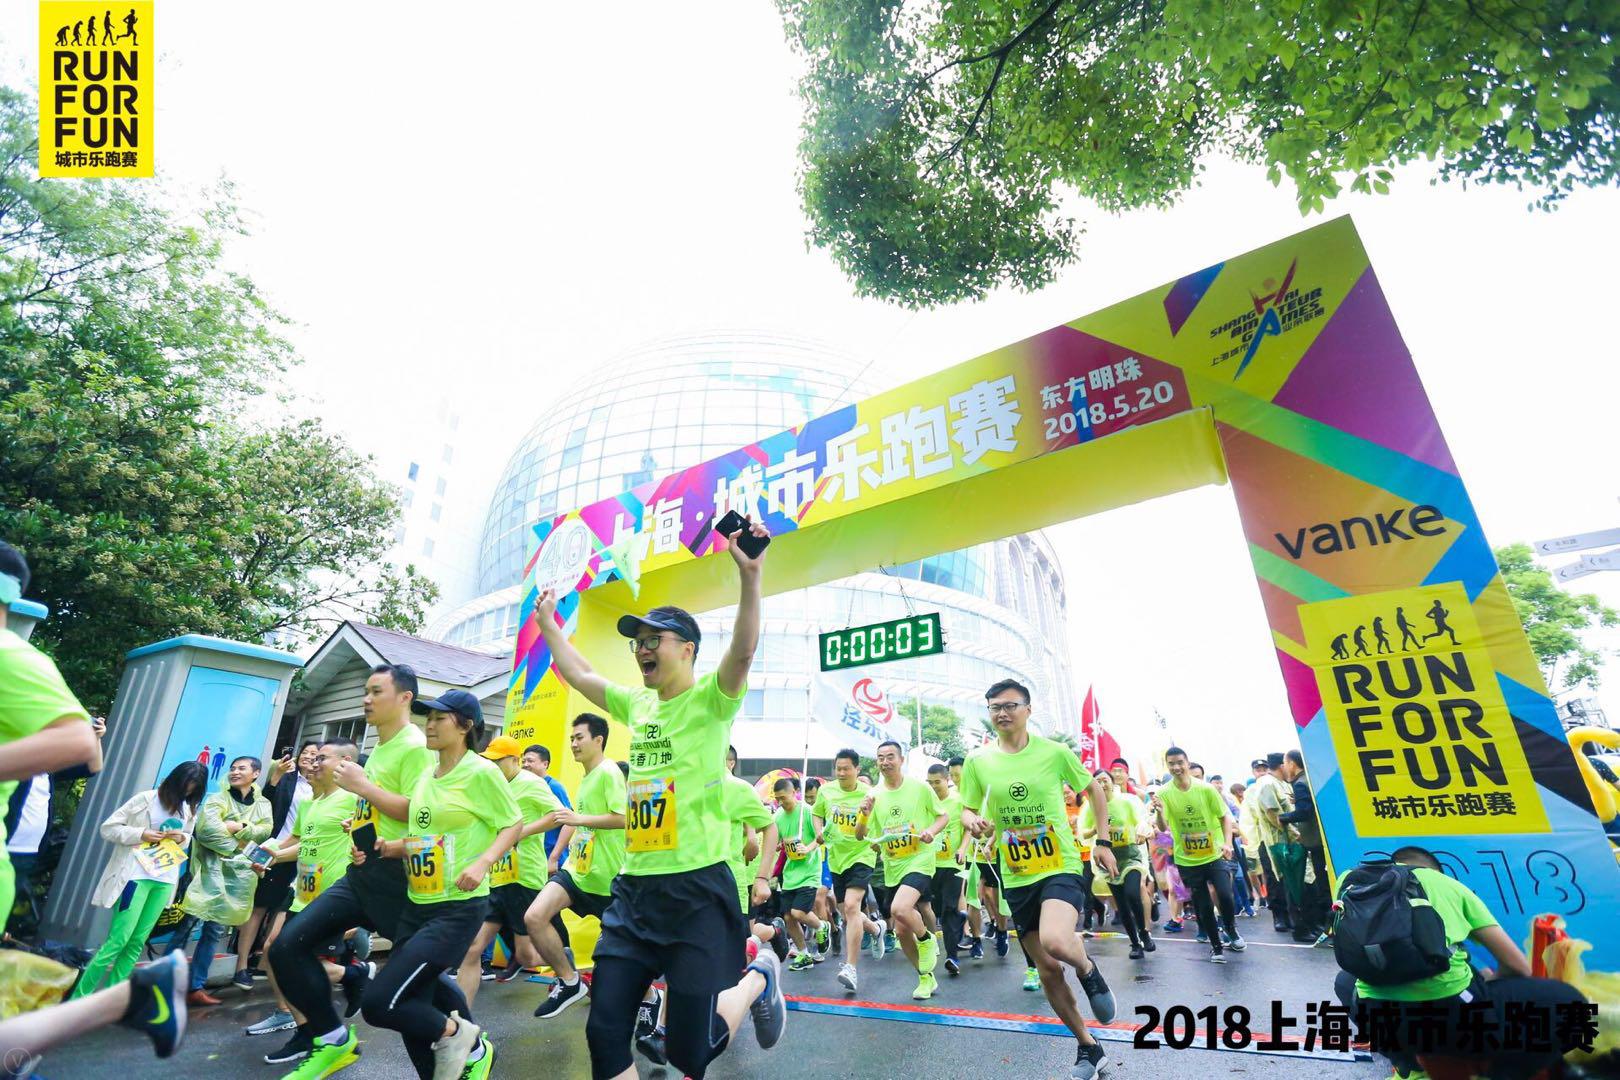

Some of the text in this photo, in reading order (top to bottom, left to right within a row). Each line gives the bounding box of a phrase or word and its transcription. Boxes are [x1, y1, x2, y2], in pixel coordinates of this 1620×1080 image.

[1040, 357, 1143, 410] 东方明珠
[1044, 381, 1173, 440] 2018.5.20
[1275, 504, 1447, 560] vanke
[826, 618, 933, 666] 0:00:03
[1332, 652, 1476, 704] RUN
[1346, 699, 1493, 748] FOR
[1359, 743, 1509, 793] FUN
[833, 812, 857, 827] 0313
[999, 803, 1045, 814] arte mundi
[1372, 792, 1517, 819] 城市乐跑赛
[1008, 836, 1055, 862] 0310
[1184, 838, 1211, 850] 0322
